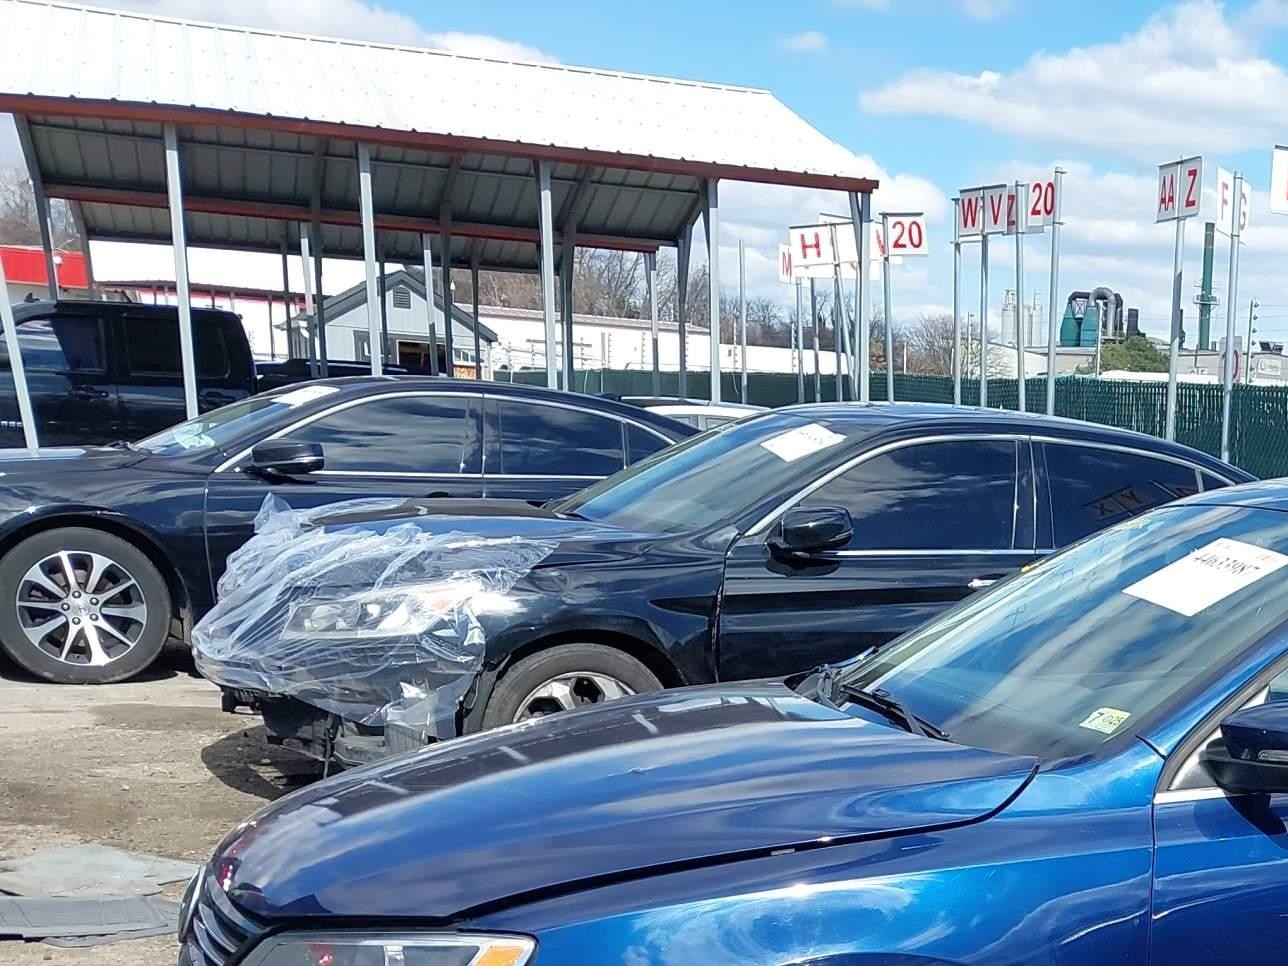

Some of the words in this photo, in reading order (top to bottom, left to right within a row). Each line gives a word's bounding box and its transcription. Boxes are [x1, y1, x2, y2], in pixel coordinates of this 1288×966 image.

[1031, 182, 1055, 216] 20
[1159, 173, 1175, 213] AA
[1185, 168, 1198, 207] Z
[1221, 181, 1229, 221] F
[961, 196, 979, 228] W
[990, 193, 1003, 225] V
[800, 231, 822, 259] H
[892, 220, 923, 249] 20
